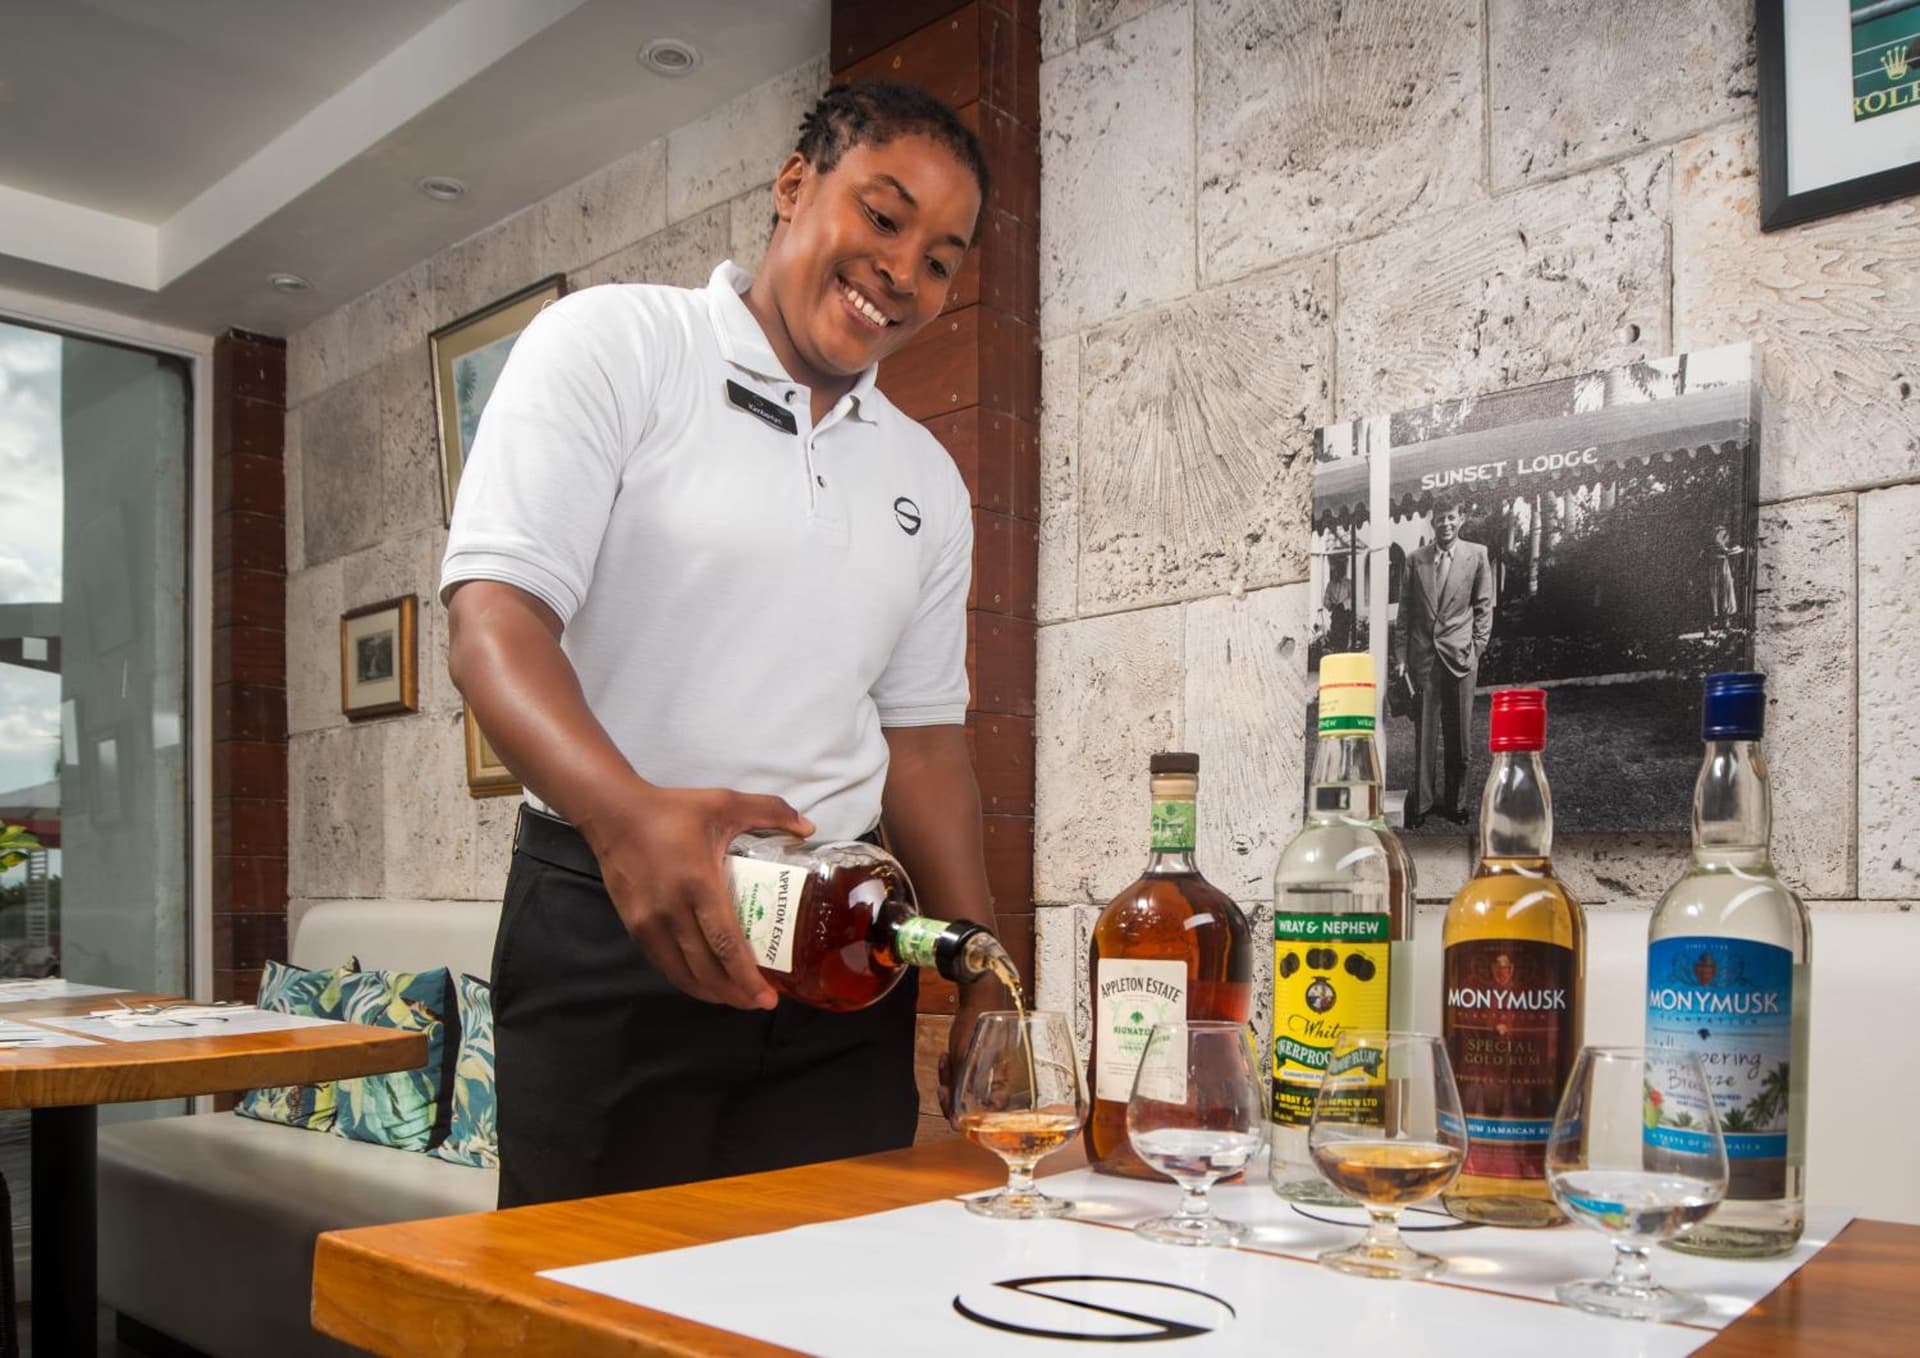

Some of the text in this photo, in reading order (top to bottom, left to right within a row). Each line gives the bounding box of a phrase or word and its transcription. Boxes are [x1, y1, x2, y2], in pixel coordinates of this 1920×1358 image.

[1421, 447, 1597, 490] SUNSET LODGE
[766, 870, 791, 965] APPLETON ESTATE
[1279, 920, 1379, 934] WRAY & NEPHEW
[1101, 977, 1182, 1003] APPLETON ESTATE
[1448, 987, 1566, 1011] MONYMUSK
[1650, 988, 1779, 1014] MONYMUSK
[1288, 1014, 1346, 1039] Whit
[1487, 1125, 1535, 1135] JAMAICAN
